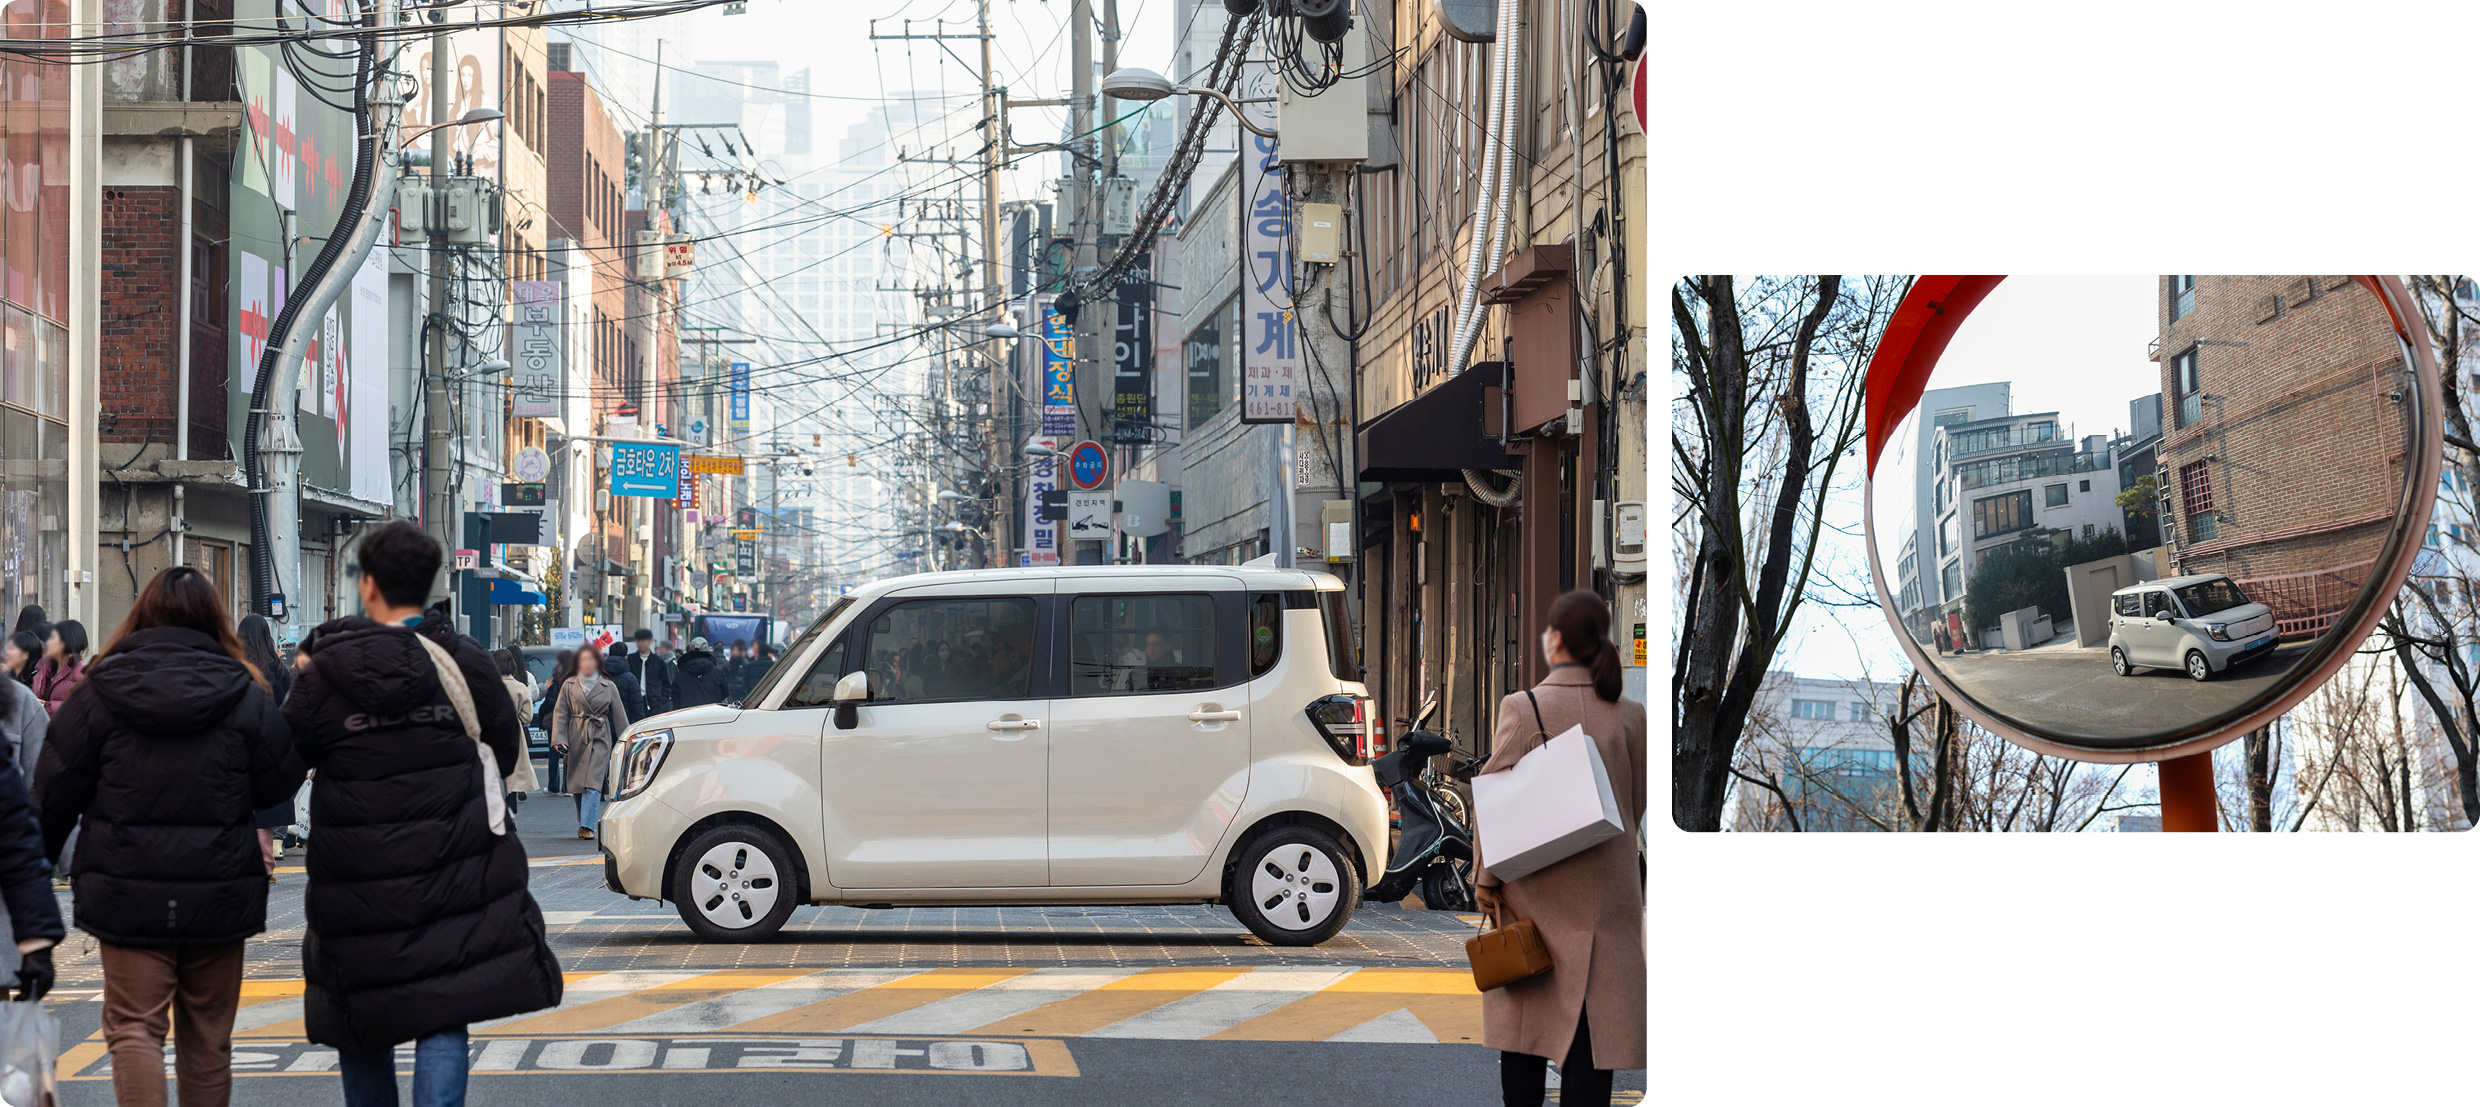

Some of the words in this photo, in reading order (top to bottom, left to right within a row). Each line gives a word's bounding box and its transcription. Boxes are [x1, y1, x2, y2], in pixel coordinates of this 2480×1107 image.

[669, 246, 687, 254] 위험
[519, 286, 555, 304] 대운
[520, 306, 555, 403] 부동산
[616, 447, 656, 478] 금호타운
[658, 450, 676, 480] 2차
[1075, 461, 1103, 470] 주차금지
[1075, 499, 1107, 507] 견인지역
[458, 556, 470, 567] TP
[343, 704, 456, 731] EIDER
[530, 731, 548, 739] 7443
